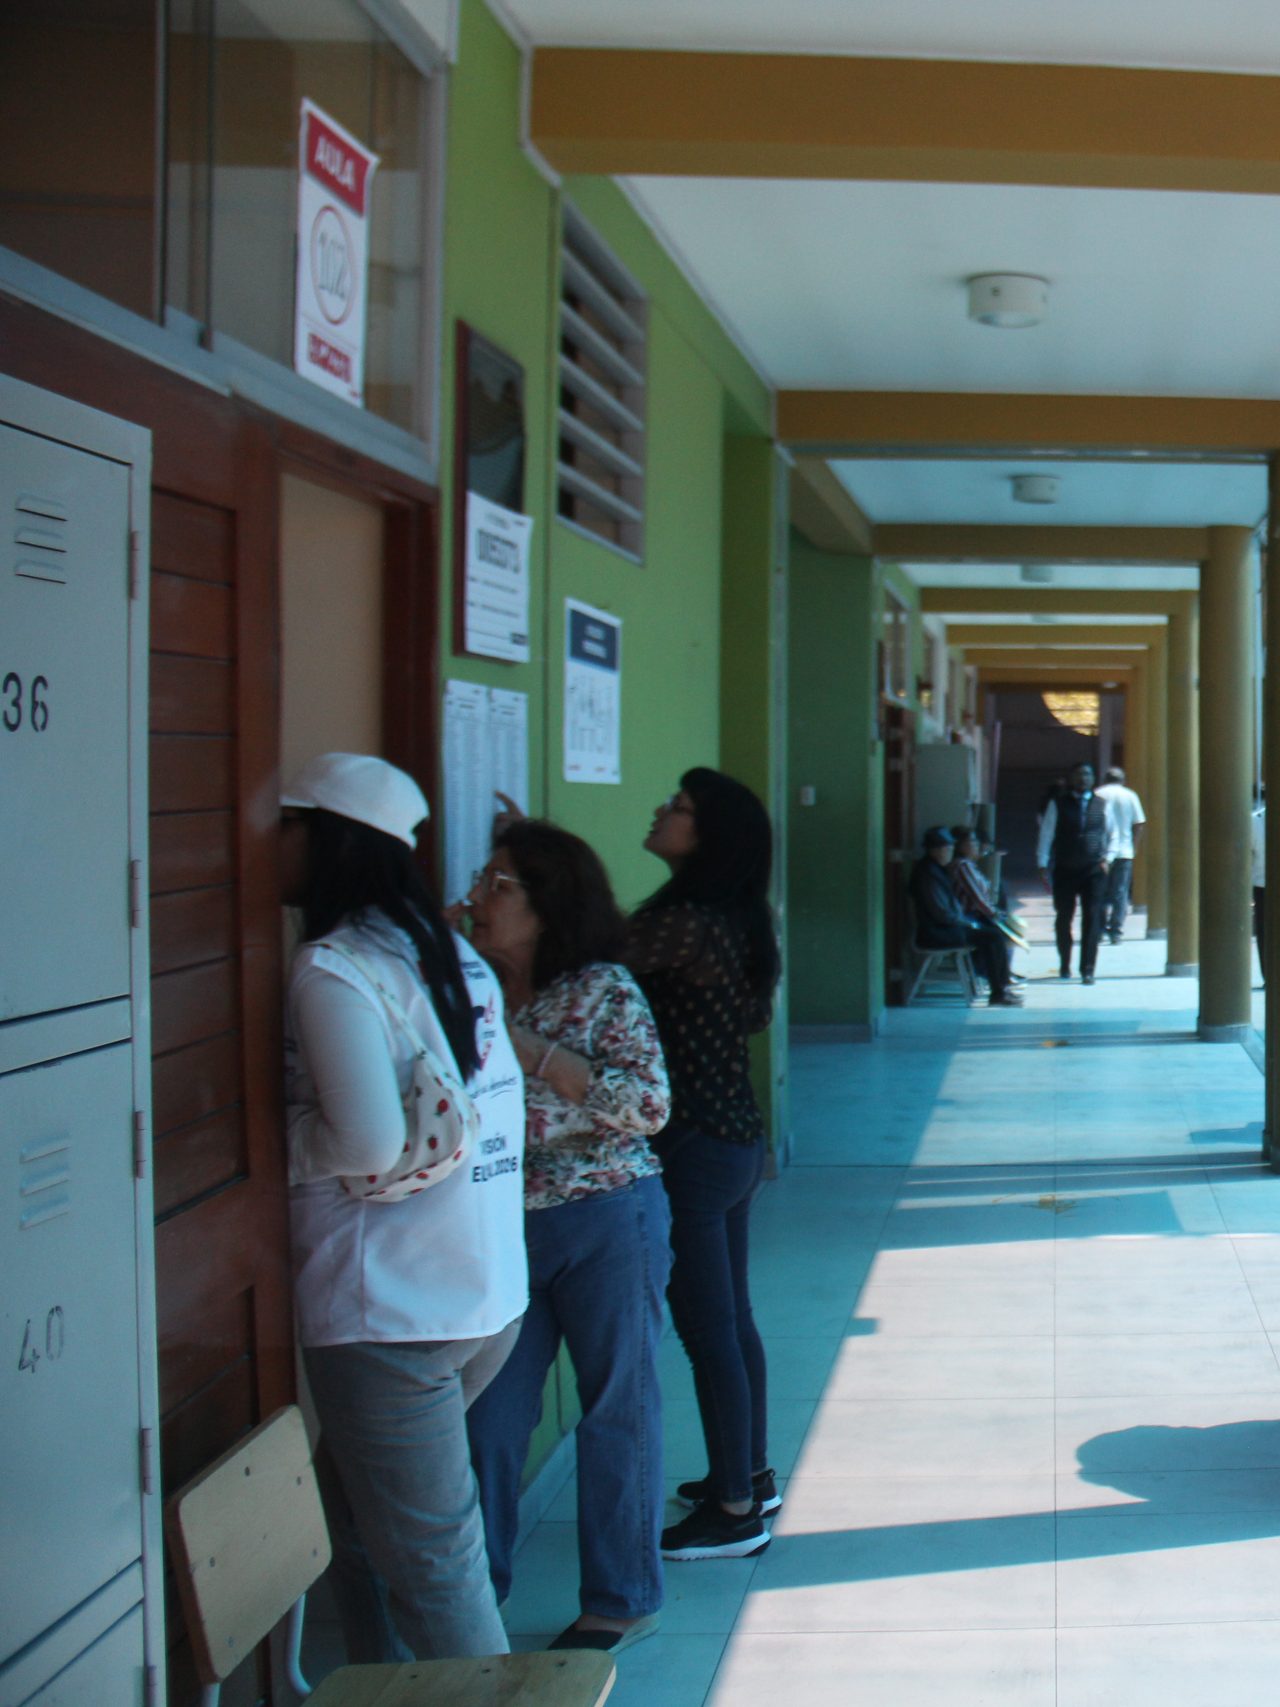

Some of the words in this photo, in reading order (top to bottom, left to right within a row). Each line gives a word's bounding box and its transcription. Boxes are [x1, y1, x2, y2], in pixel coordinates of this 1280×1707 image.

[314, 135, 355, 192] AULA
[3, 672, 48, 732] 36
[18, 1305, 64, 1374] 40
